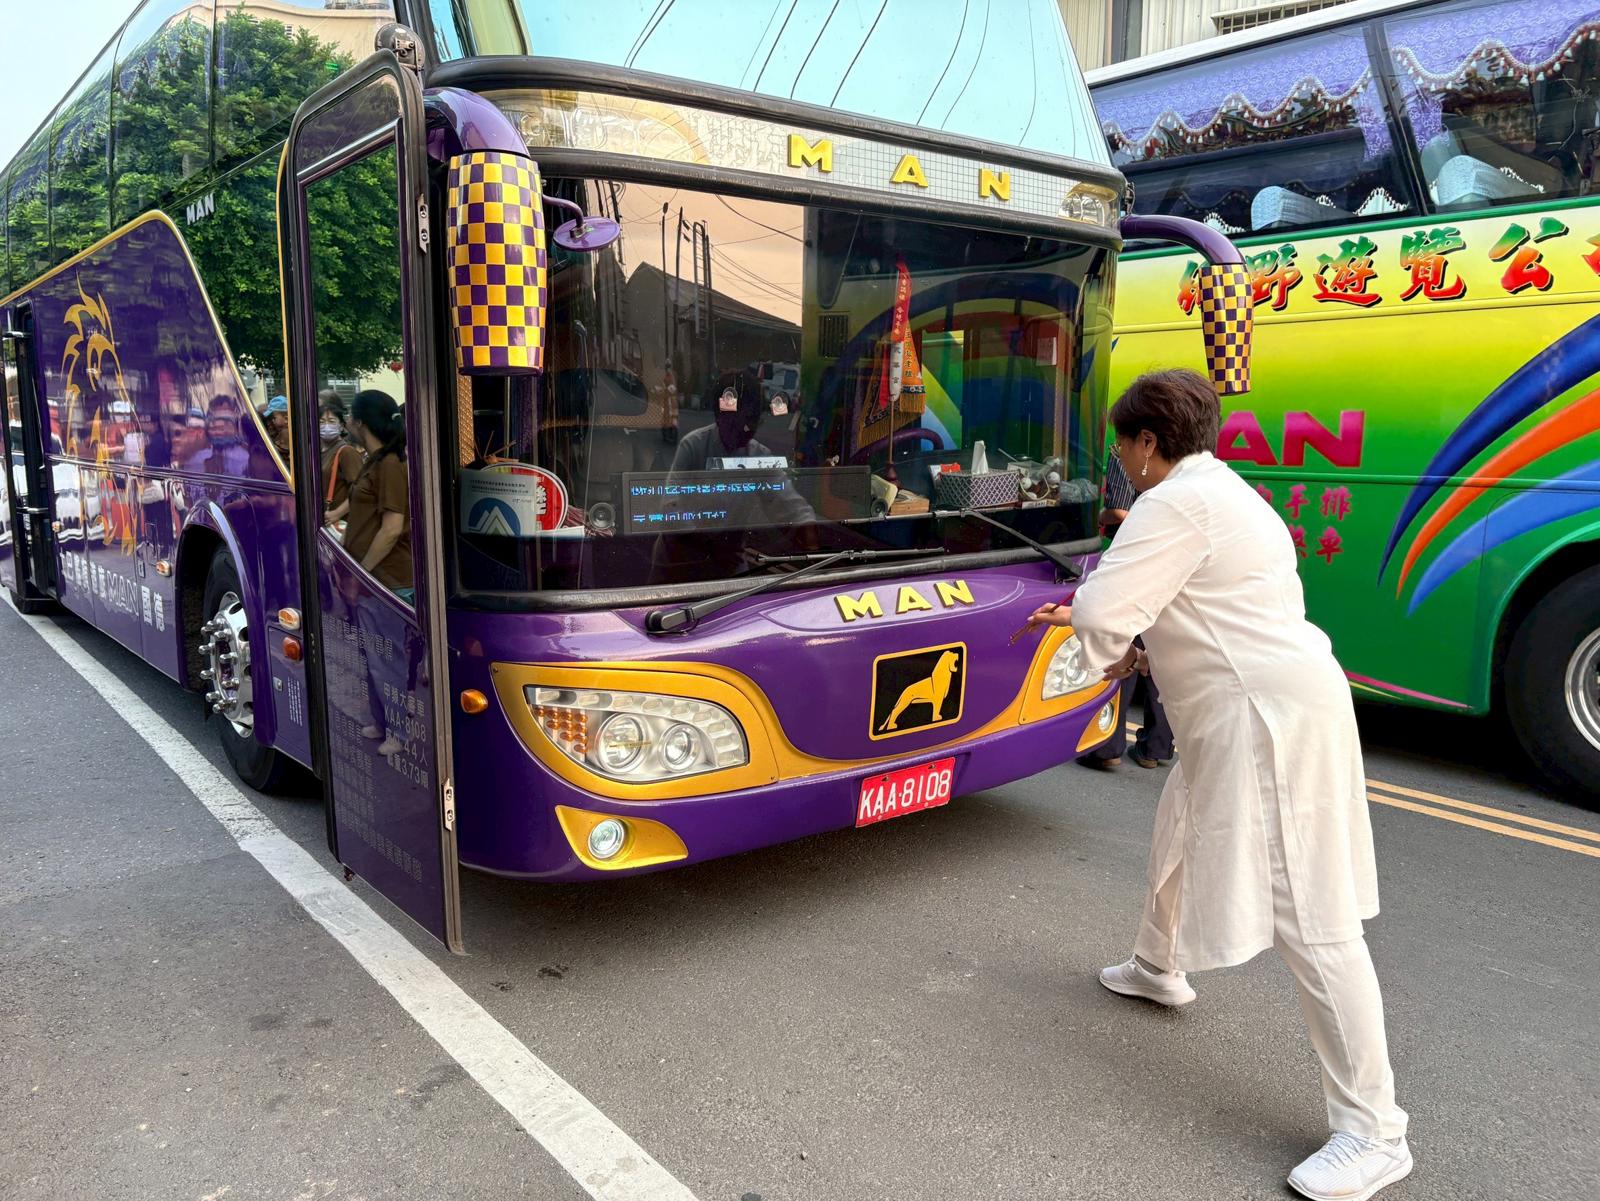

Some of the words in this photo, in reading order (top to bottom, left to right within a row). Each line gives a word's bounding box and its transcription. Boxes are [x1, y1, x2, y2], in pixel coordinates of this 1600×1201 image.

[788, 134, 1011, 201] MAN
[187, 192, 215, 225] MAN
[1178, 216, 1600, 315] 野遊覽公
[1255, 483, 1352, 521] 手排
[834, 579, 975, 623] MAN
